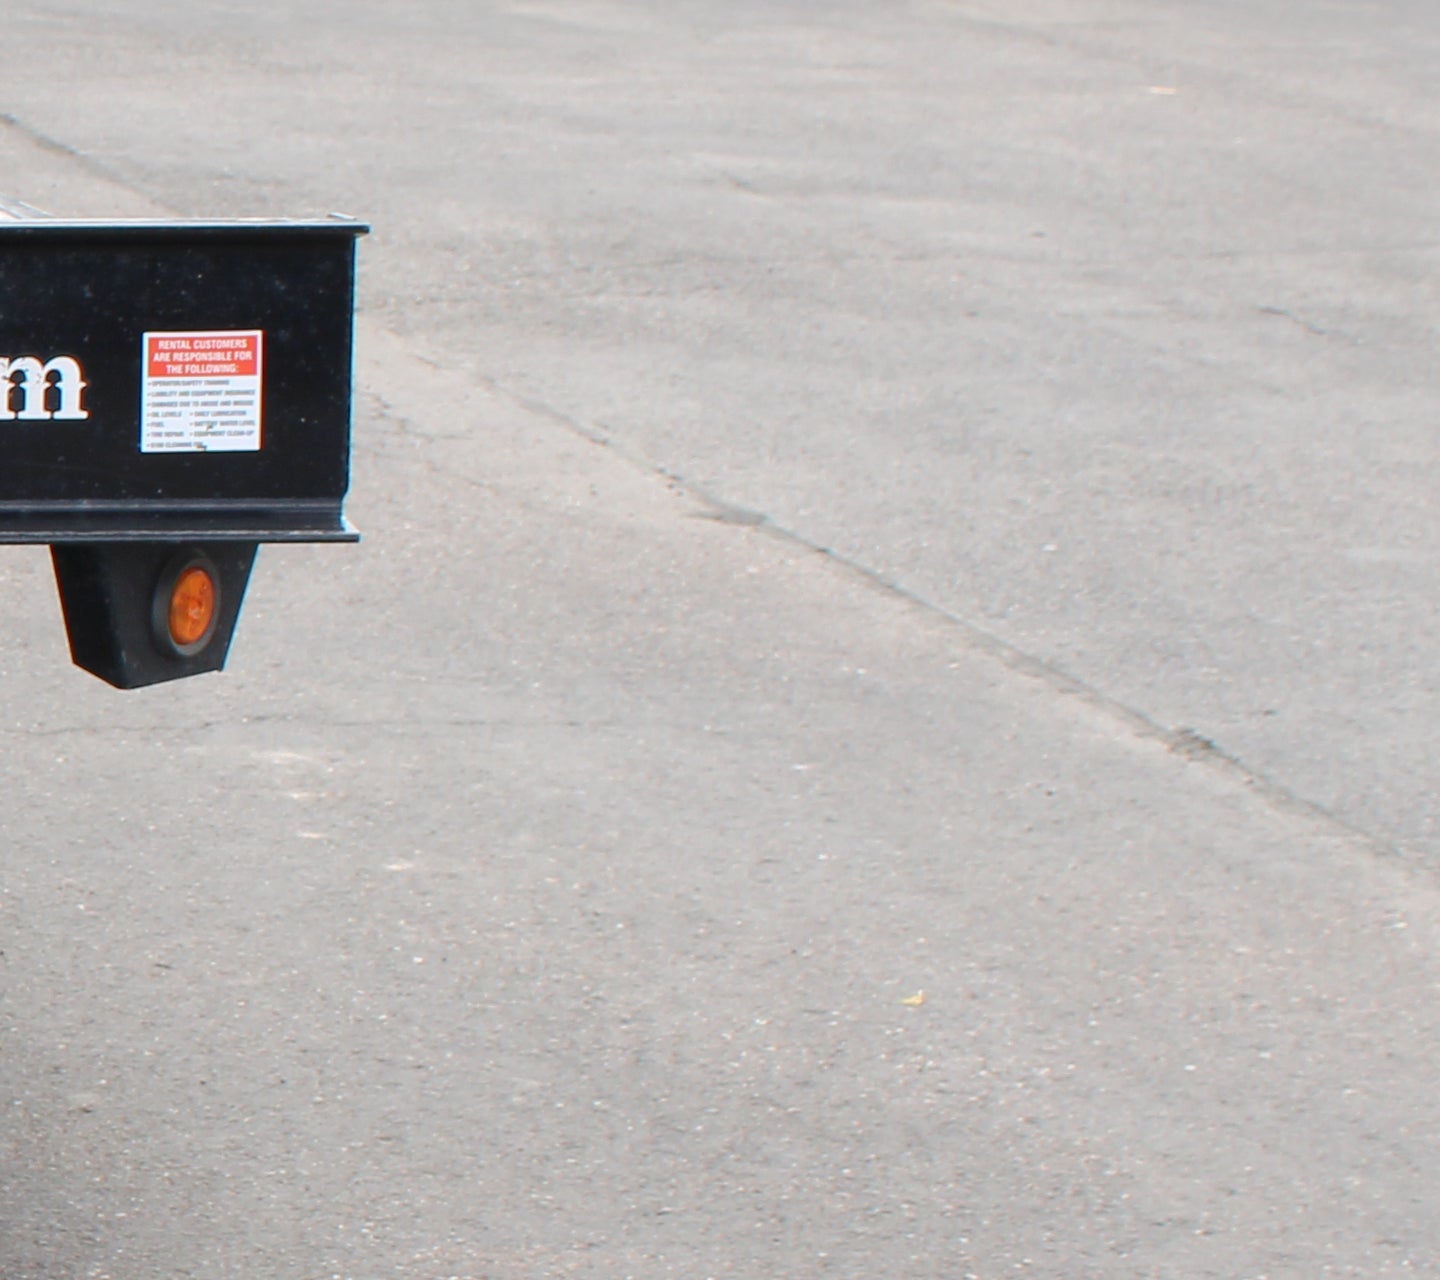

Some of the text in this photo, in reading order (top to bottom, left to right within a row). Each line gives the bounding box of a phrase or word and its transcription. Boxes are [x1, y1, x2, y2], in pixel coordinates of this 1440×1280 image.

[158, 338, 248, 350] RENTAL CUSTOMERS
[153, 351, 253, 362] ARE RESPONSIBLE FOR
[166, 363, 239, 374] THE FOLLOWING:
